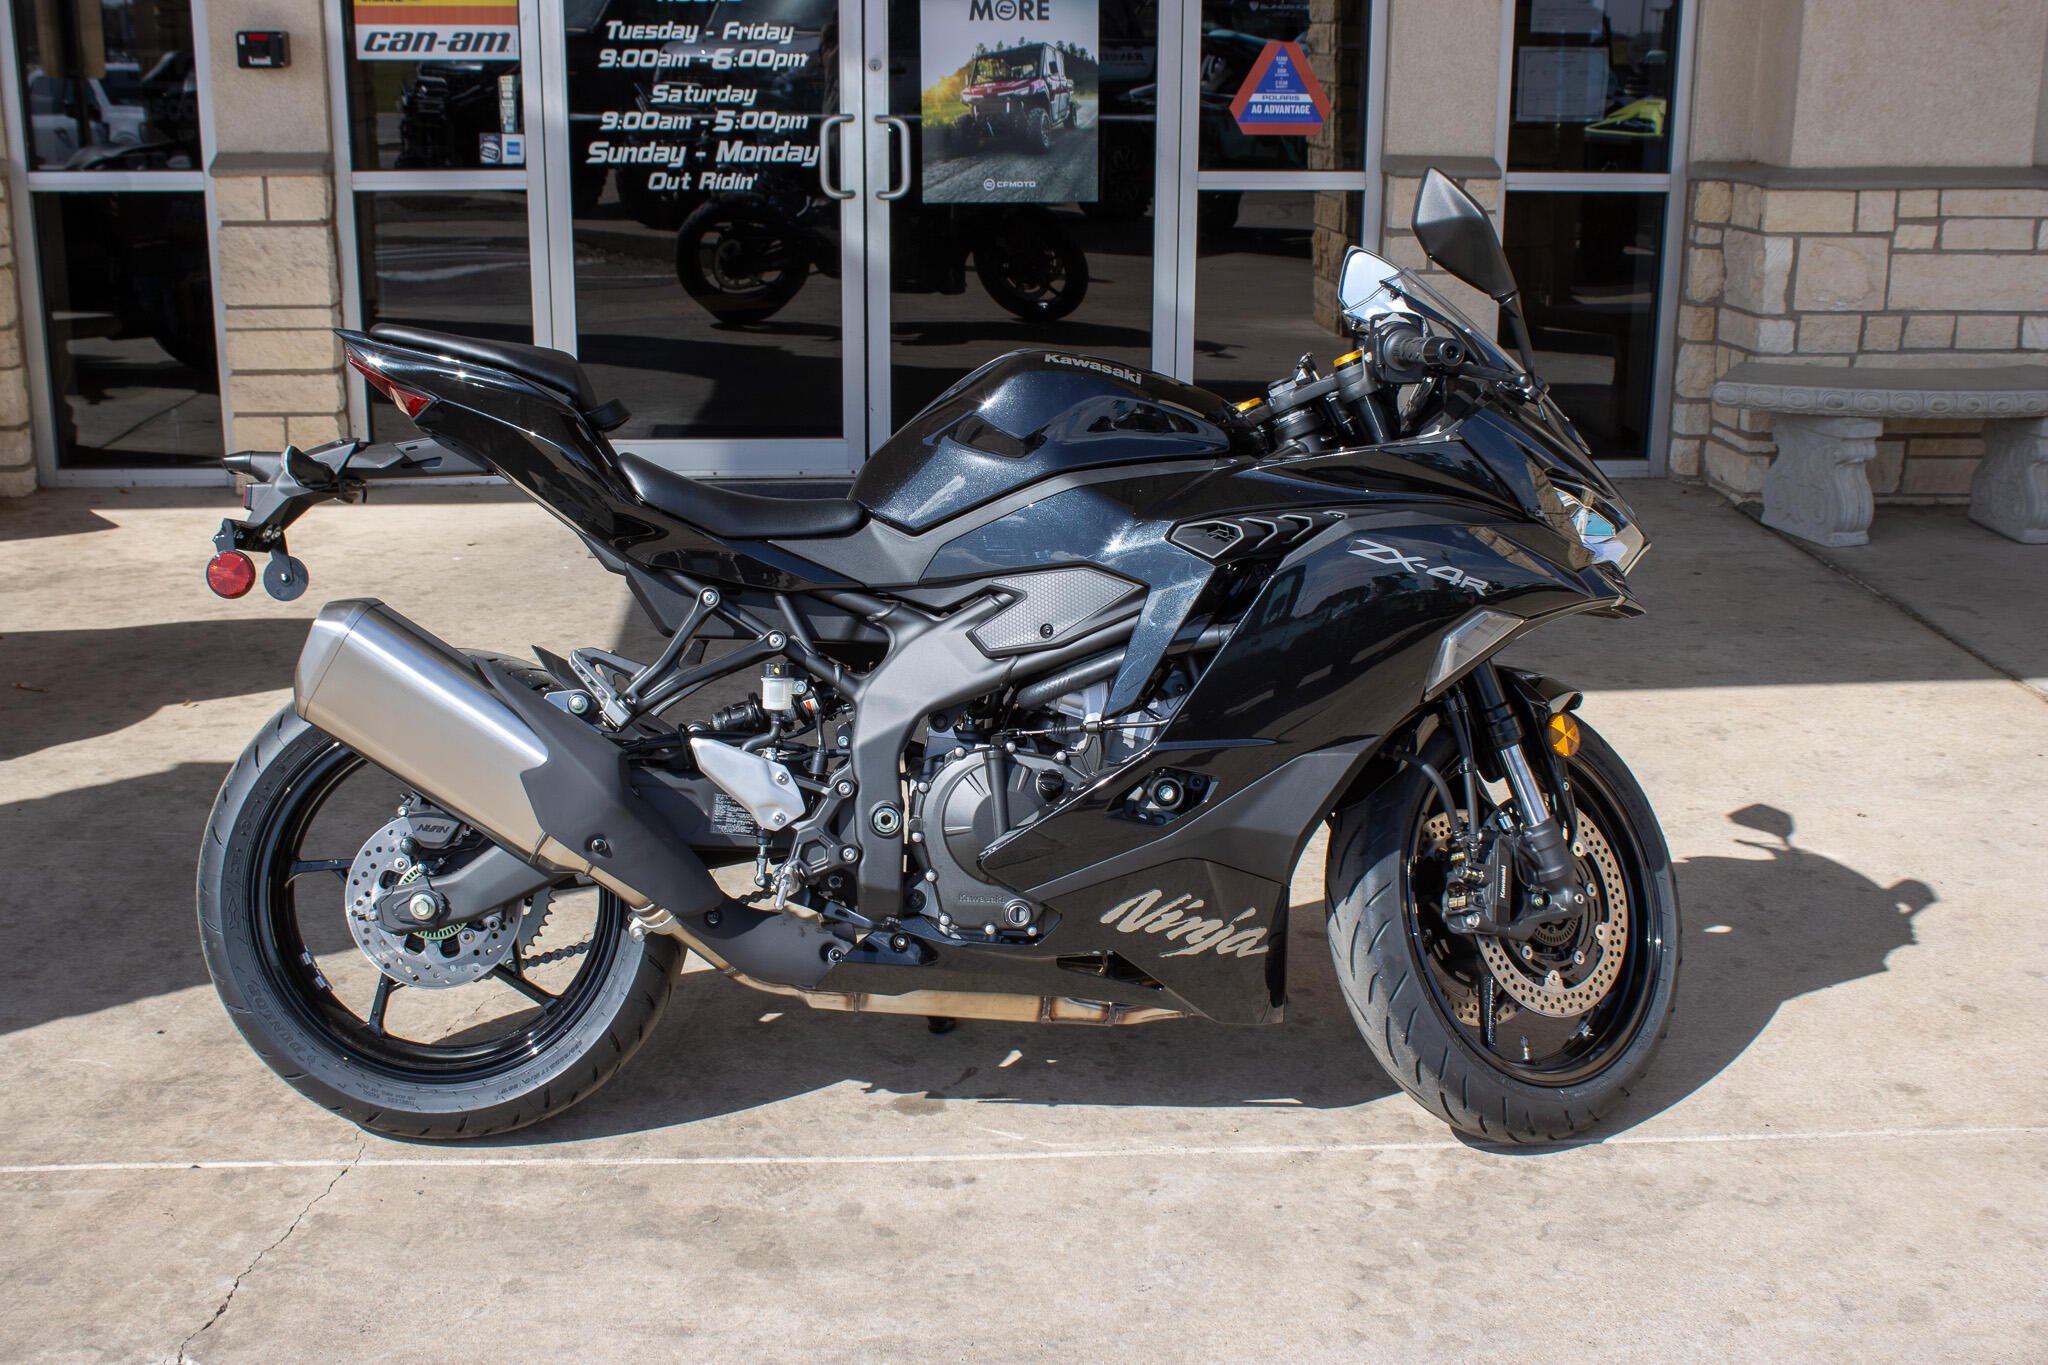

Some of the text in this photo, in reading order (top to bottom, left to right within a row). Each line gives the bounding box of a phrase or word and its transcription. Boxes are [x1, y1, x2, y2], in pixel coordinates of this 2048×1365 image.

[363, 31, 512, 53] can-am
[605, 20, 700, 44] Tuesday
[722, 21, 795, 45] Friday
[598, 48, 690, 69] 9:00am
[711, 47, 809, 71] 6:00pm
[650, 84, 757, 107] Saturday
[1251, 104, 1311, 114] AG ADVANTAGE
[600, 111, 692, 130] 9:00am
[712, 110, 809, 133] 5:00pm
[585, 141, 687, 168] Sunday
[715, 140, 820, 167] Monday
[648, 172, 759, 191] Out Ridin'
[1044, 353, 1142, 385] Kawasaki
[1347, 539, 1487, 597] ZX-4R
[1099, 889, 1270, 958] Ninja
